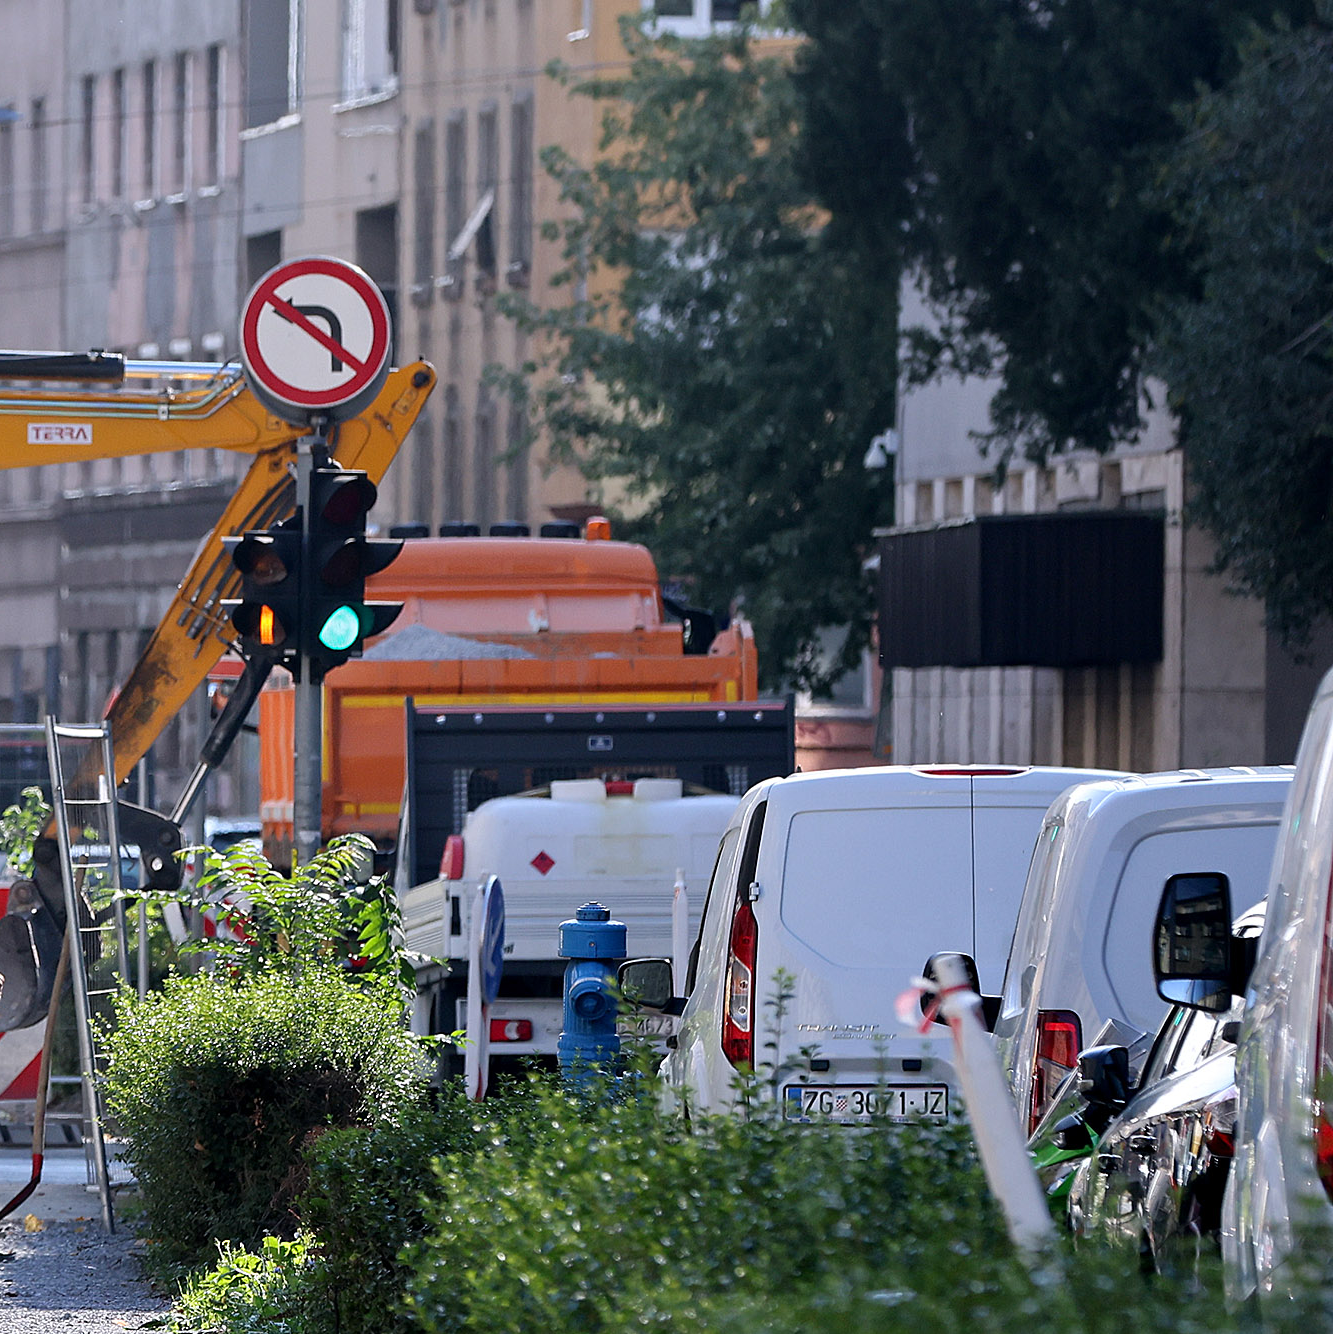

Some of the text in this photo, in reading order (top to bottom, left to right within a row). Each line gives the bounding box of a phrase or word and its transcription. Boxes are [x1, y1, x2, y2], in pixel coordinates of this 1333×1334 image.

[32, 426, 88, 440] TERRA
[797, 1024, 879, 1032] TRANSIT
[804, 1091, 833, 1116] ZG
